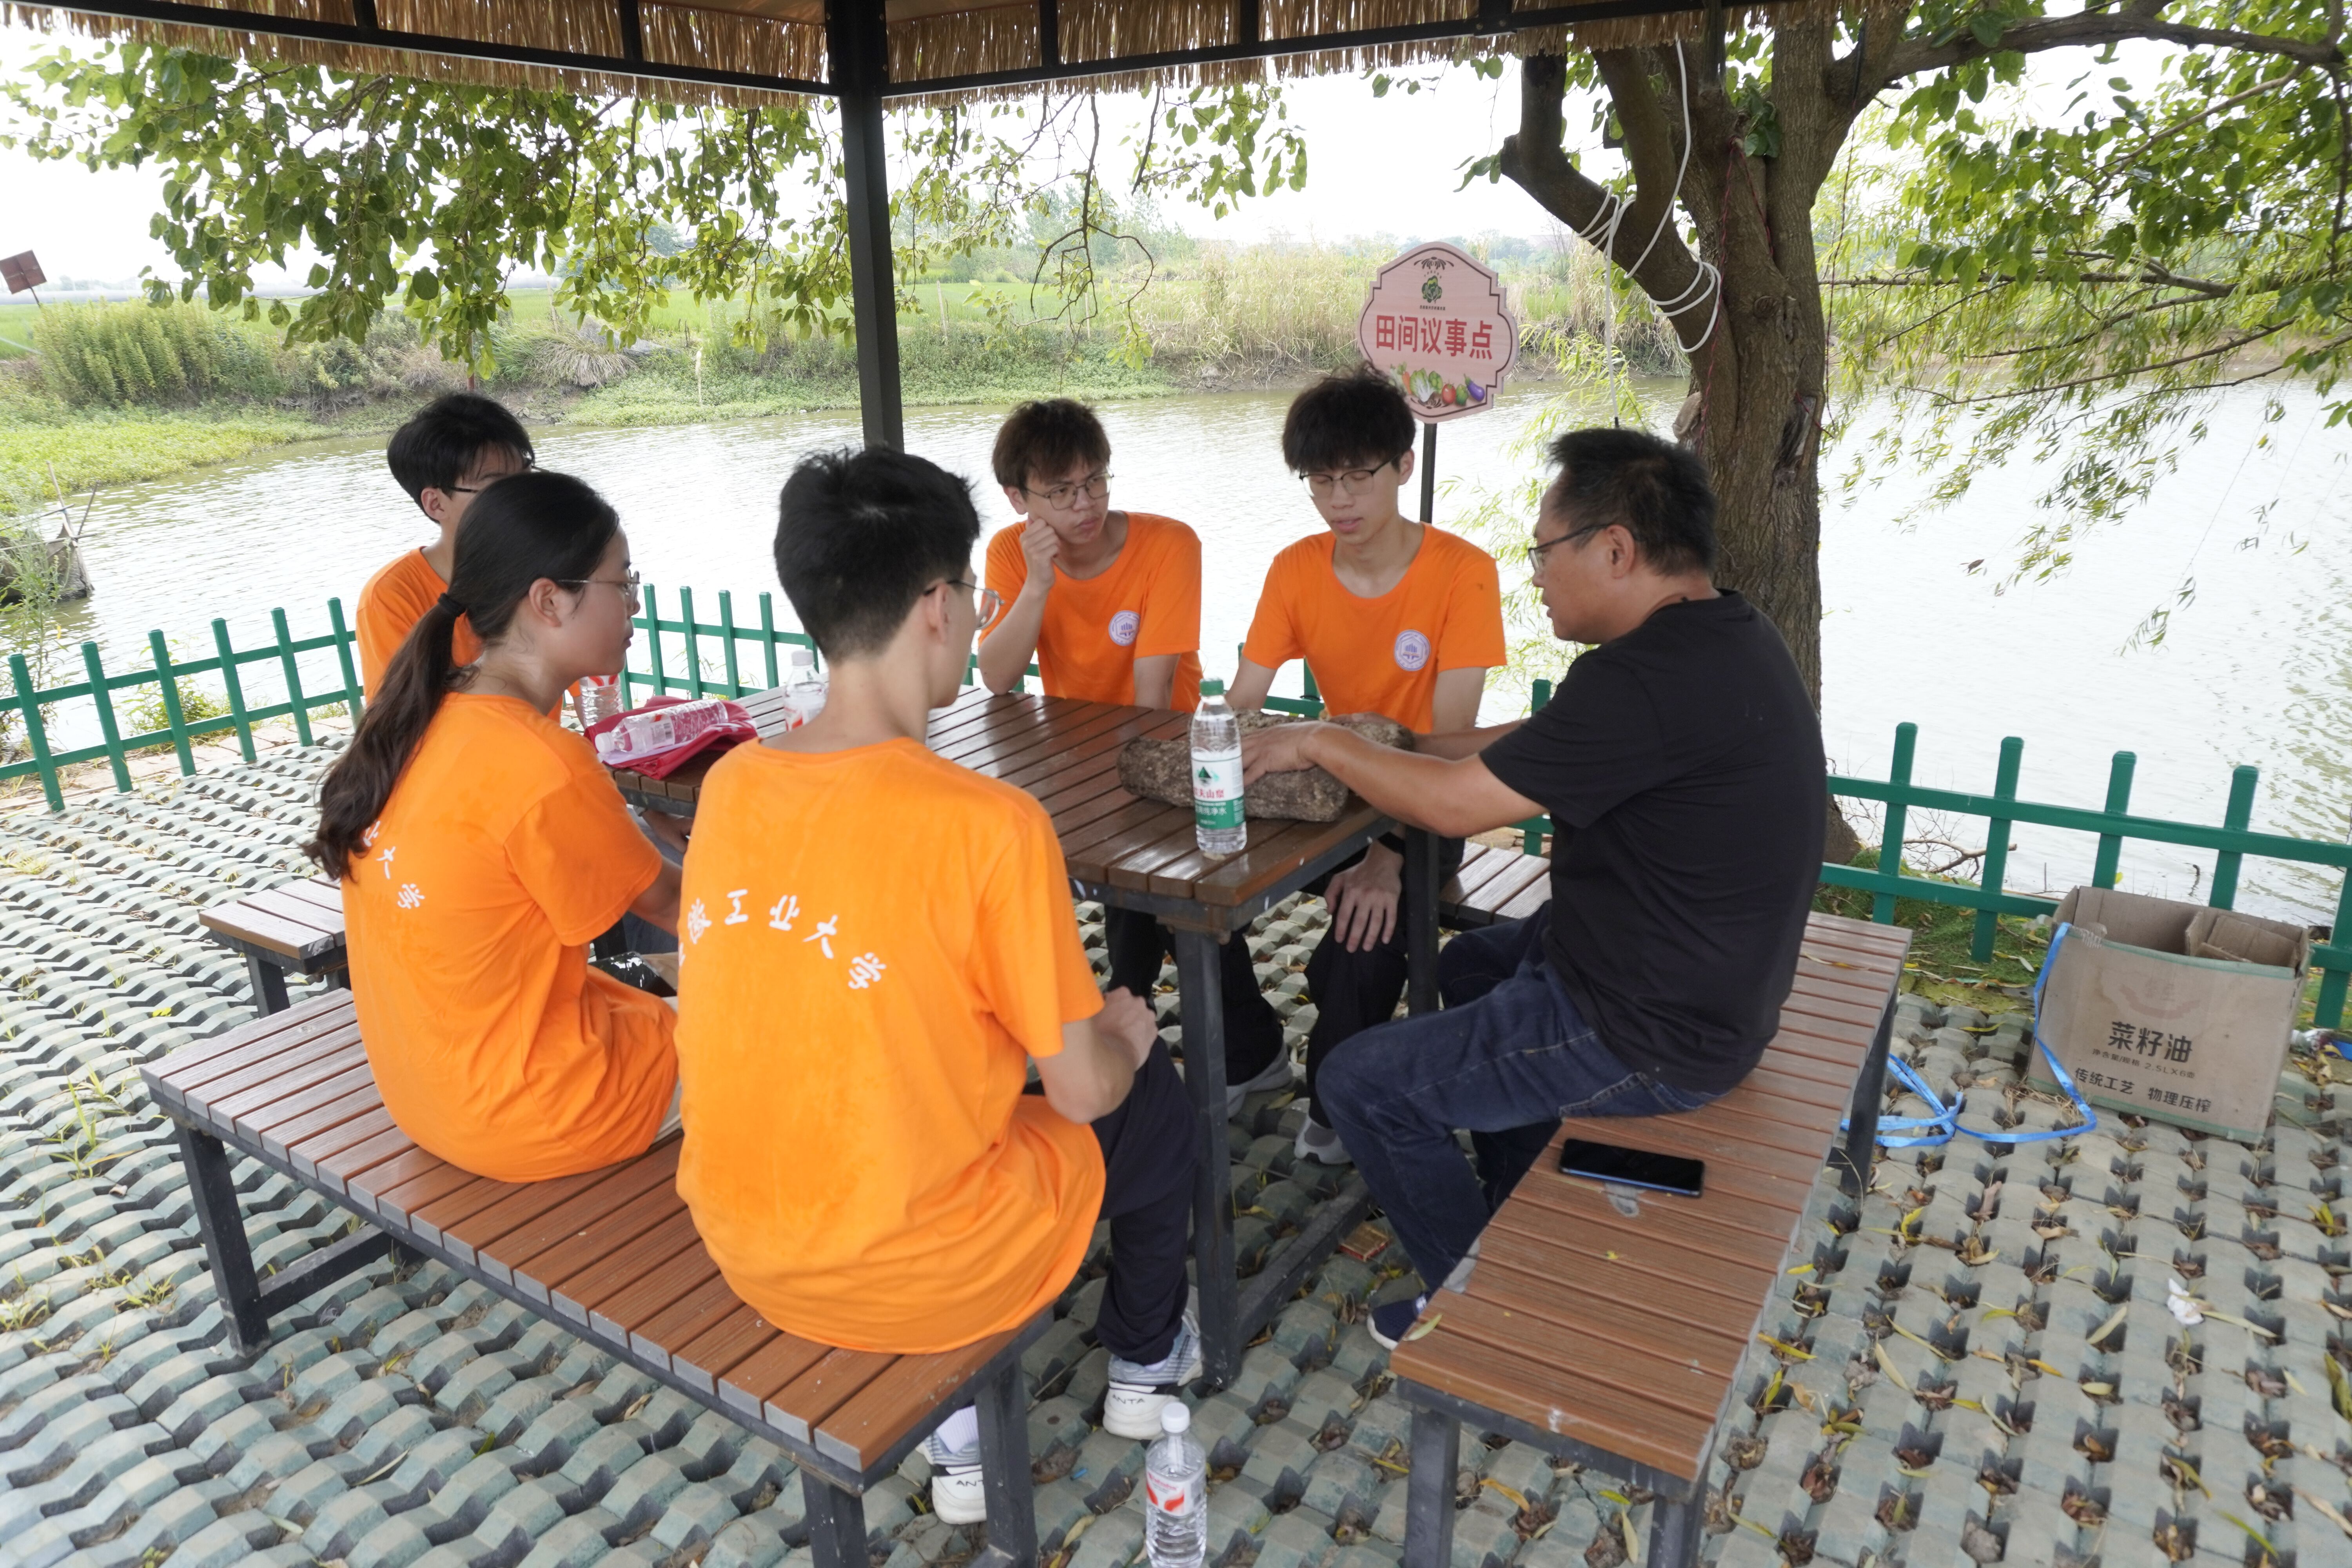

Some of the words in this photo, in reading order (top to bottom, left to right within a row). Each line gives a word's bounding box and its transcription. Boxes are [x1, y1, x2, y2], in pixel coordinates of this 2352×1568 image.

[1376, 315, 1492, 359] 田间议事点
[2108, 1021, 2192, 1063] 菜籽油
[2075, 1068, 2135, 1095] 传统工艺
[2148, 1087, 2212, 1113] 物理压榨
[1112, 1394, 1145, 1404] ANTA
